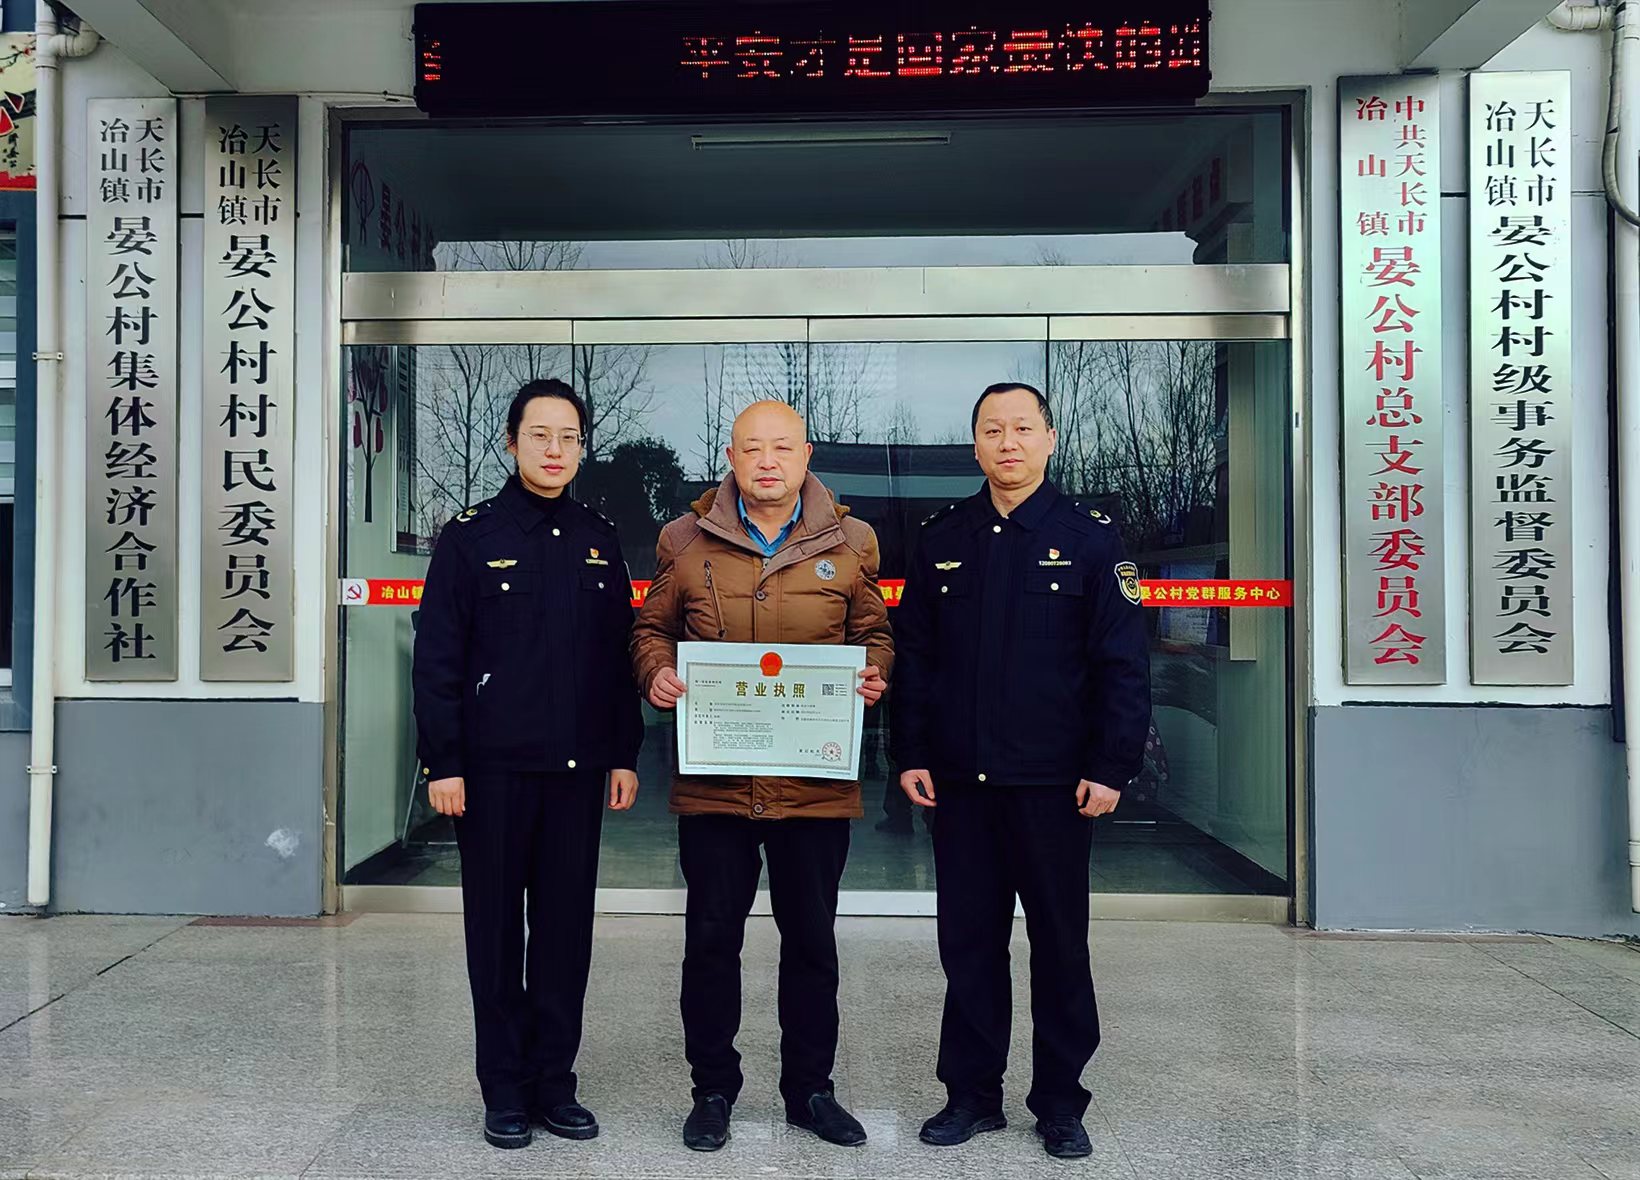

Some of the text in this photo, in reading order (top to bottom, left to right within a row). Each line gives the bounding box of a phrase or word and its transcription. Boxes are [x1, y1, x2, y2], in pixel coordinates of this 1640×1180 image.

[99, 118, 130, 203] 冶山镇
[135, 118, 165, 203] 天长市
[217, 124, 248, 225] 冶山镇
[251, 123, 282, 225] 天长市
[1355, 96, 1389, 236] 冶山镇
[1394, 95, 1428, 236] 中共天长市
[1485, 100, 1518, 207] 冶山镇
[1523, 99, 1557, 206] 天长市
[103, 216, 160, 662] 晏公村集体经济合作社
[217, 234, 279, 653] 晏公村村民委员会
[1361, 246, 1429, 665] 晏公村总支部委员会
[1487, 215, 1557, 654] 晏公村村级事务监督委员会
[1139, 586, 1281, 601] 晏公村党群服务中心
[736, 681, 806, 698] 营业执照
